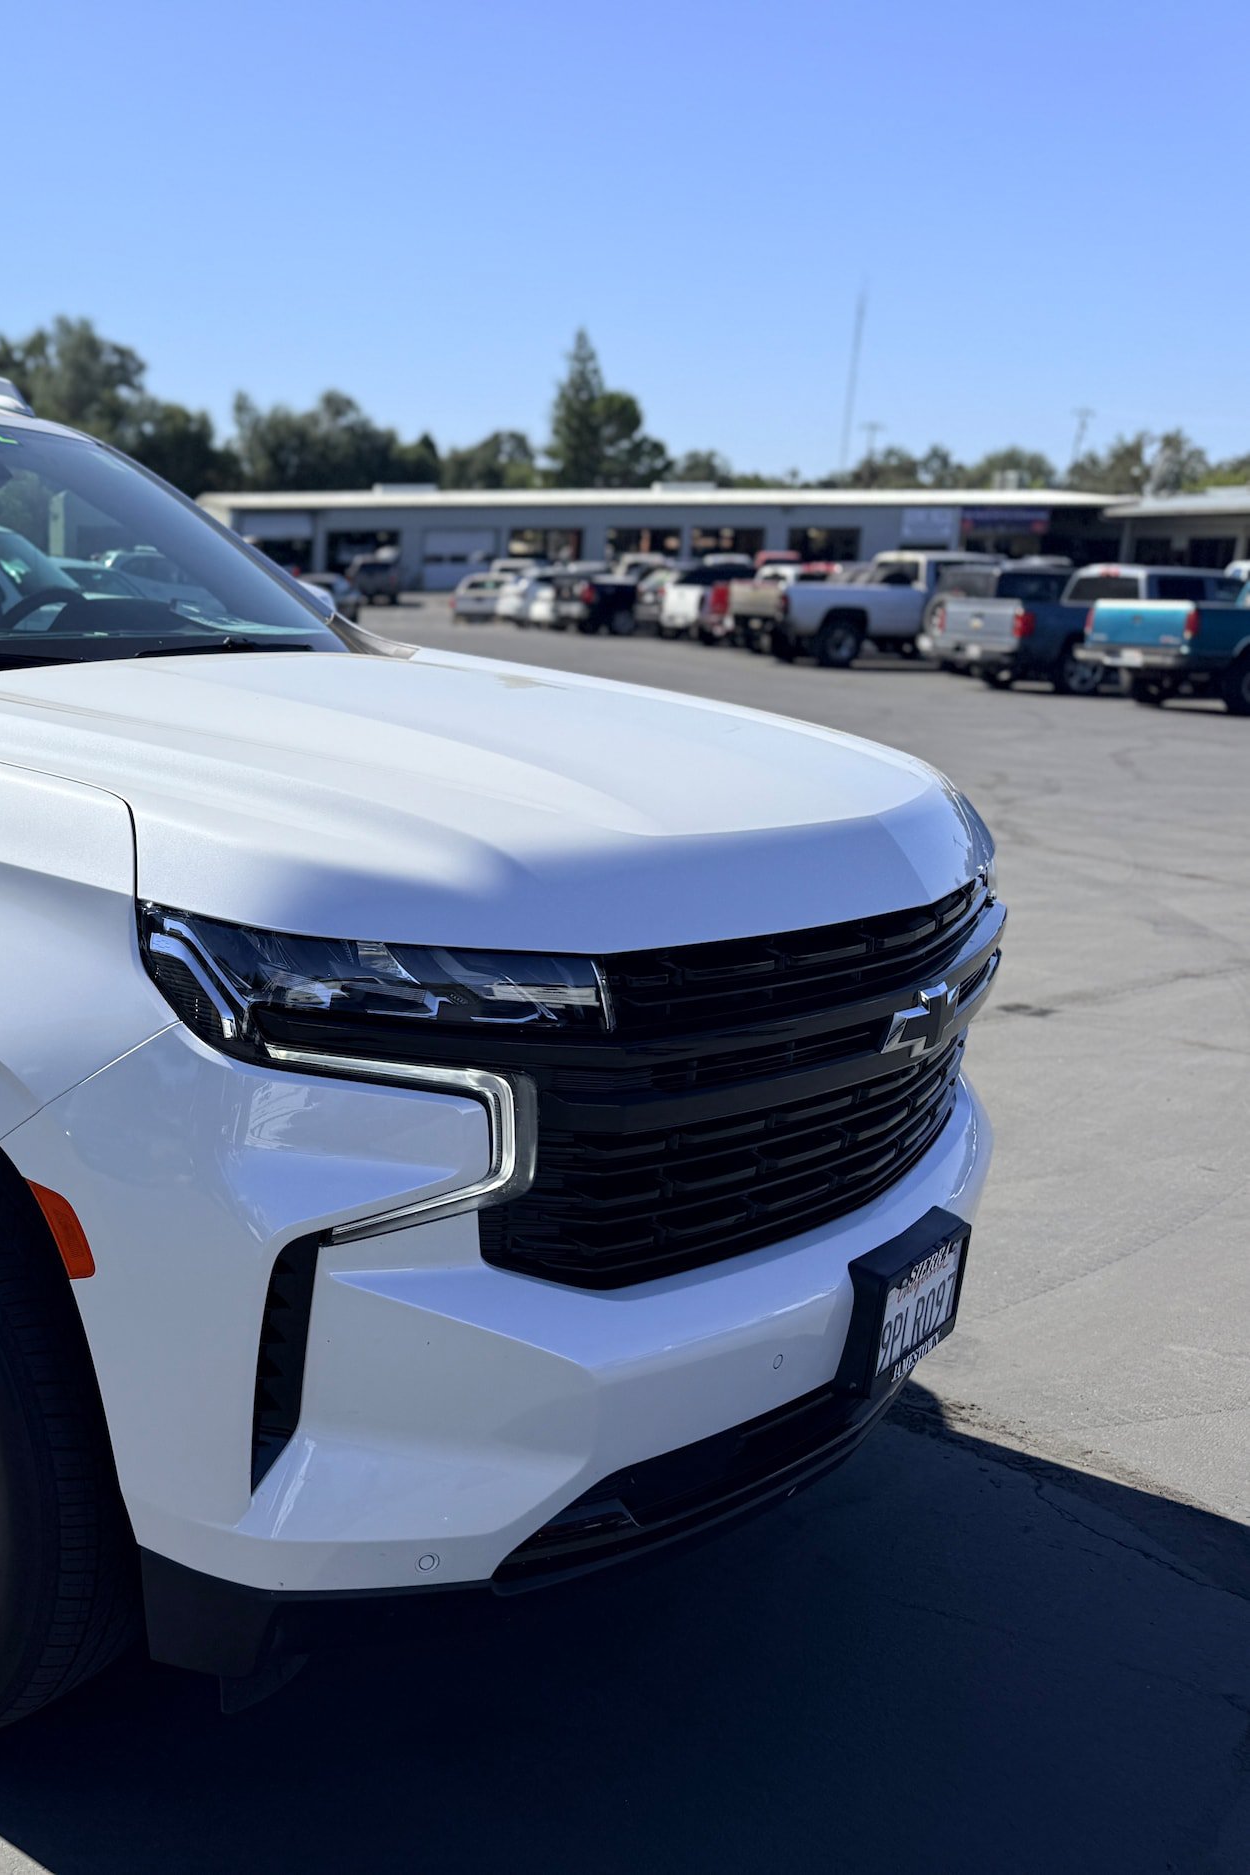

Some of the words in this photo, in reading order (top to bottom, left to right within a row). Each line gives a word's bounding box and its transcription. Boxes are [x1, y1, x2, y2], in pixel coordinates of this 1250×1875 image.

[908, 1240, 953, 1287] SIERRA
[878, 1270, 957, 1374] 9PLR097
[891, 1329, 942, 1383] JAMESTOWN
